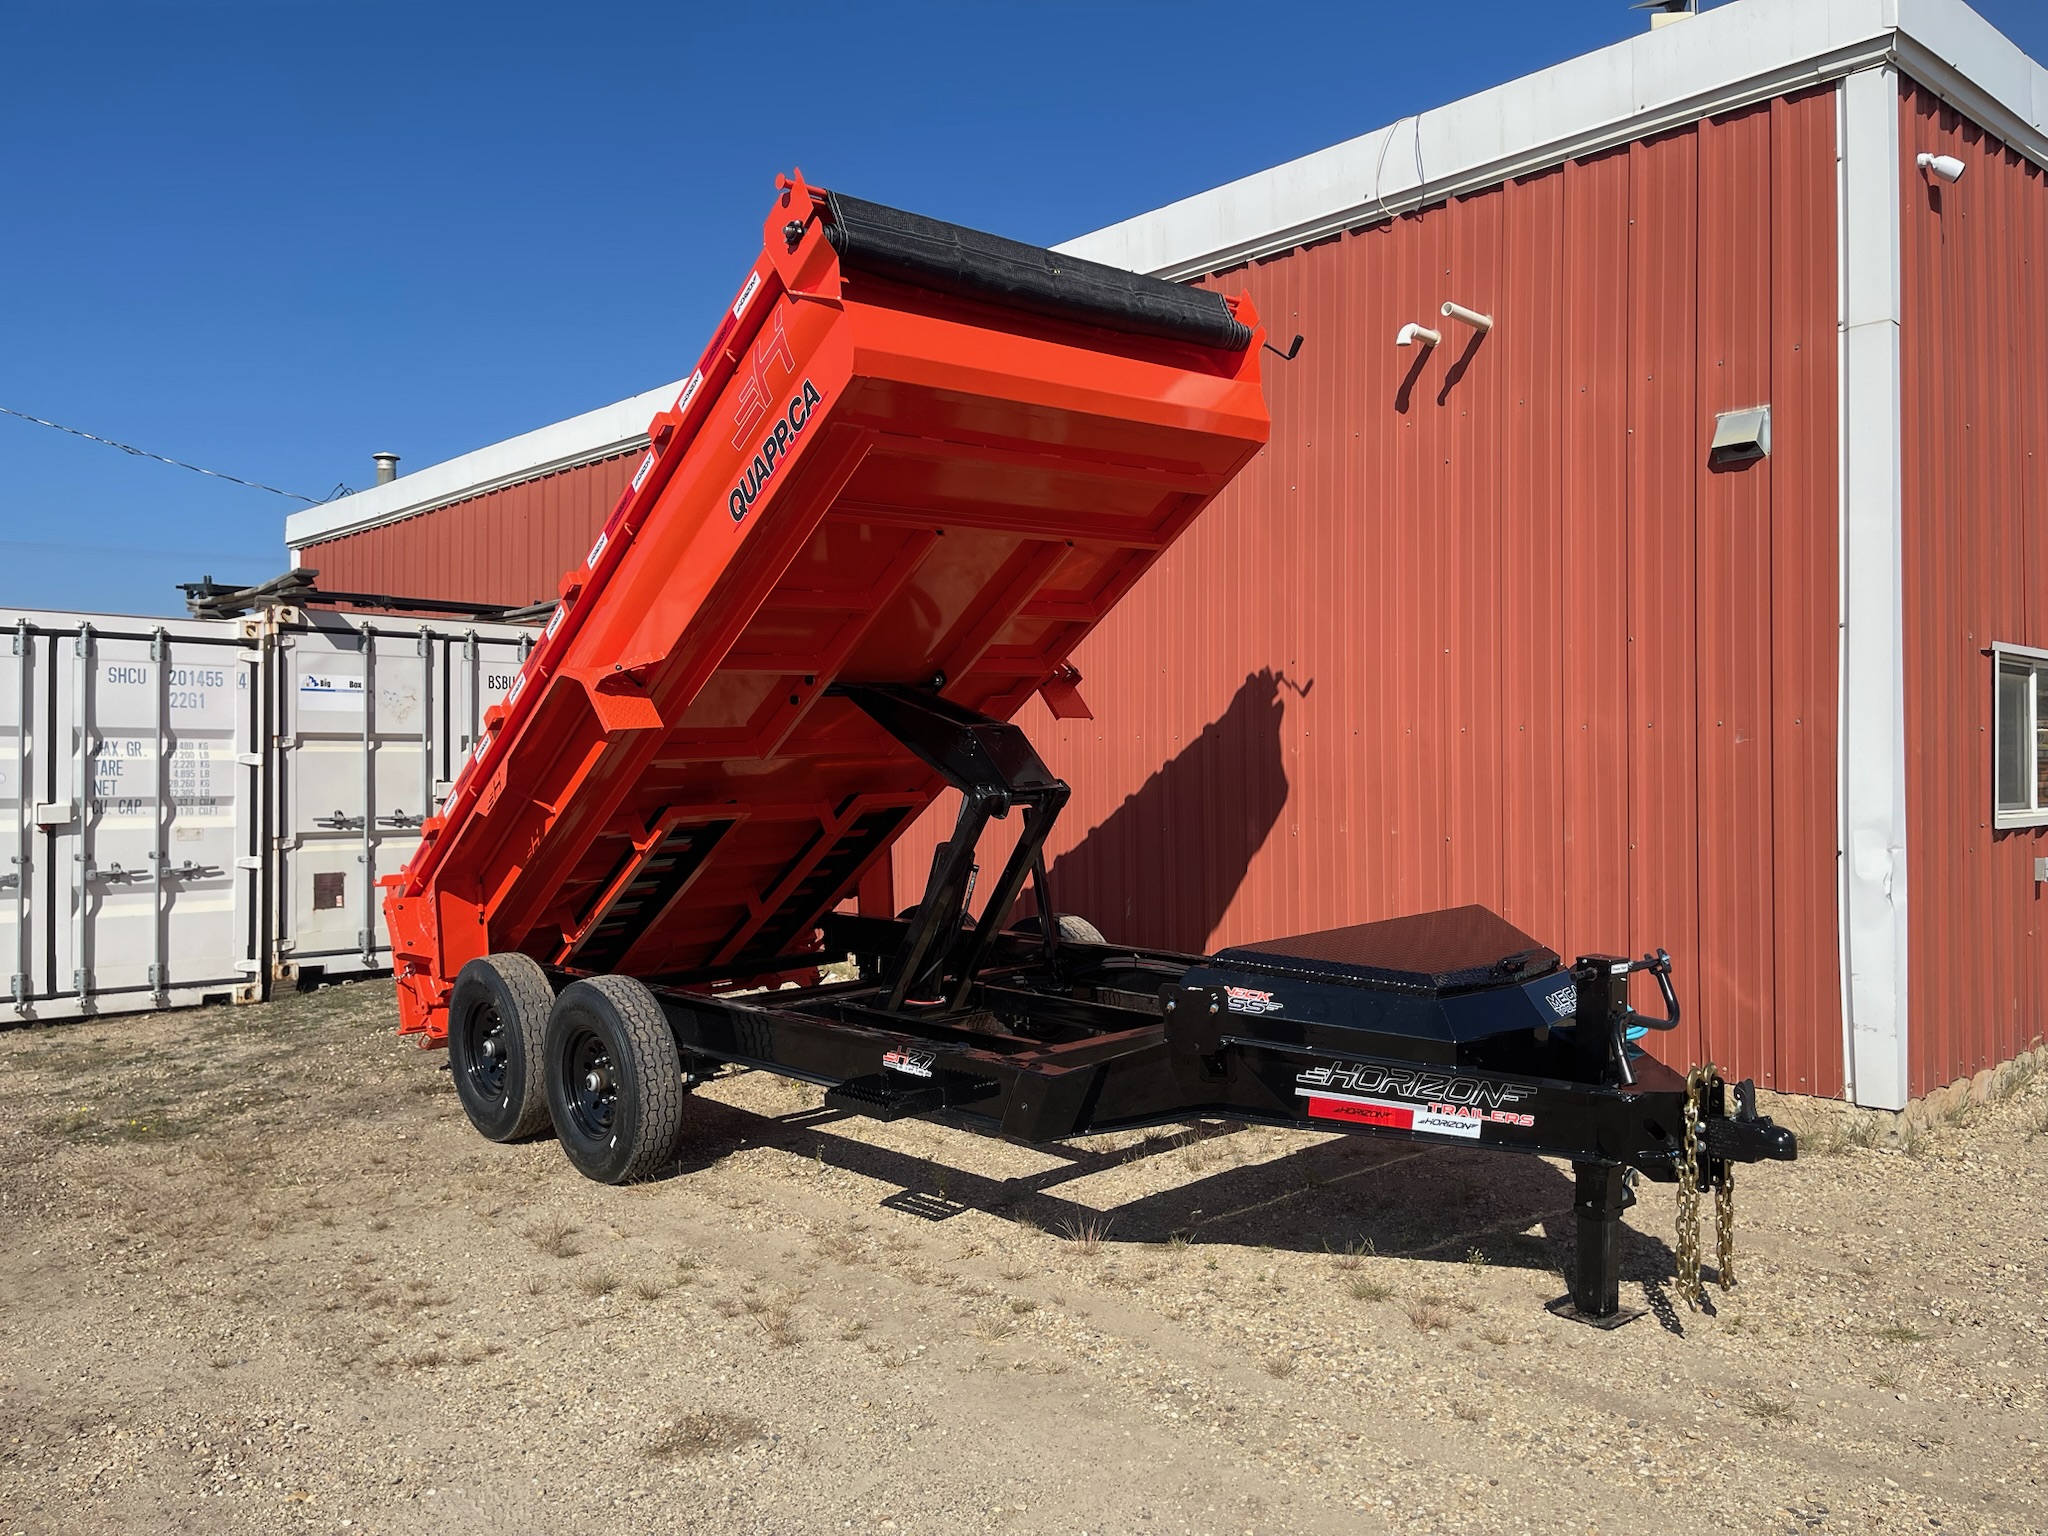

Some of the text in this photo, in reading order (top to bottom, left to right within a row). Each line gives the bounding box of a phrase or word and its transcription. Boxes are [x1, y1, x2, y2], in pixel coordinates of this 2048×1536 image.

[728, 378, 822, 522] QUAPP.CA
[108, 667, 248, 689] SHCU 201455 4
[320, 678, 362, 688] Big Box
[170, 692, 206, 709] 22G1
[94, 760, 124, 776] TARE
[93, 780, 117, 796] NET
[1322, 1060, 1512, 1108] HORIZON
[1336, 1106, 1388, 1119] HORIZON
[1426, 1101, 1535, 1127] TRAILERS
[1421, 1117, 1475, 1130] HORIZON
